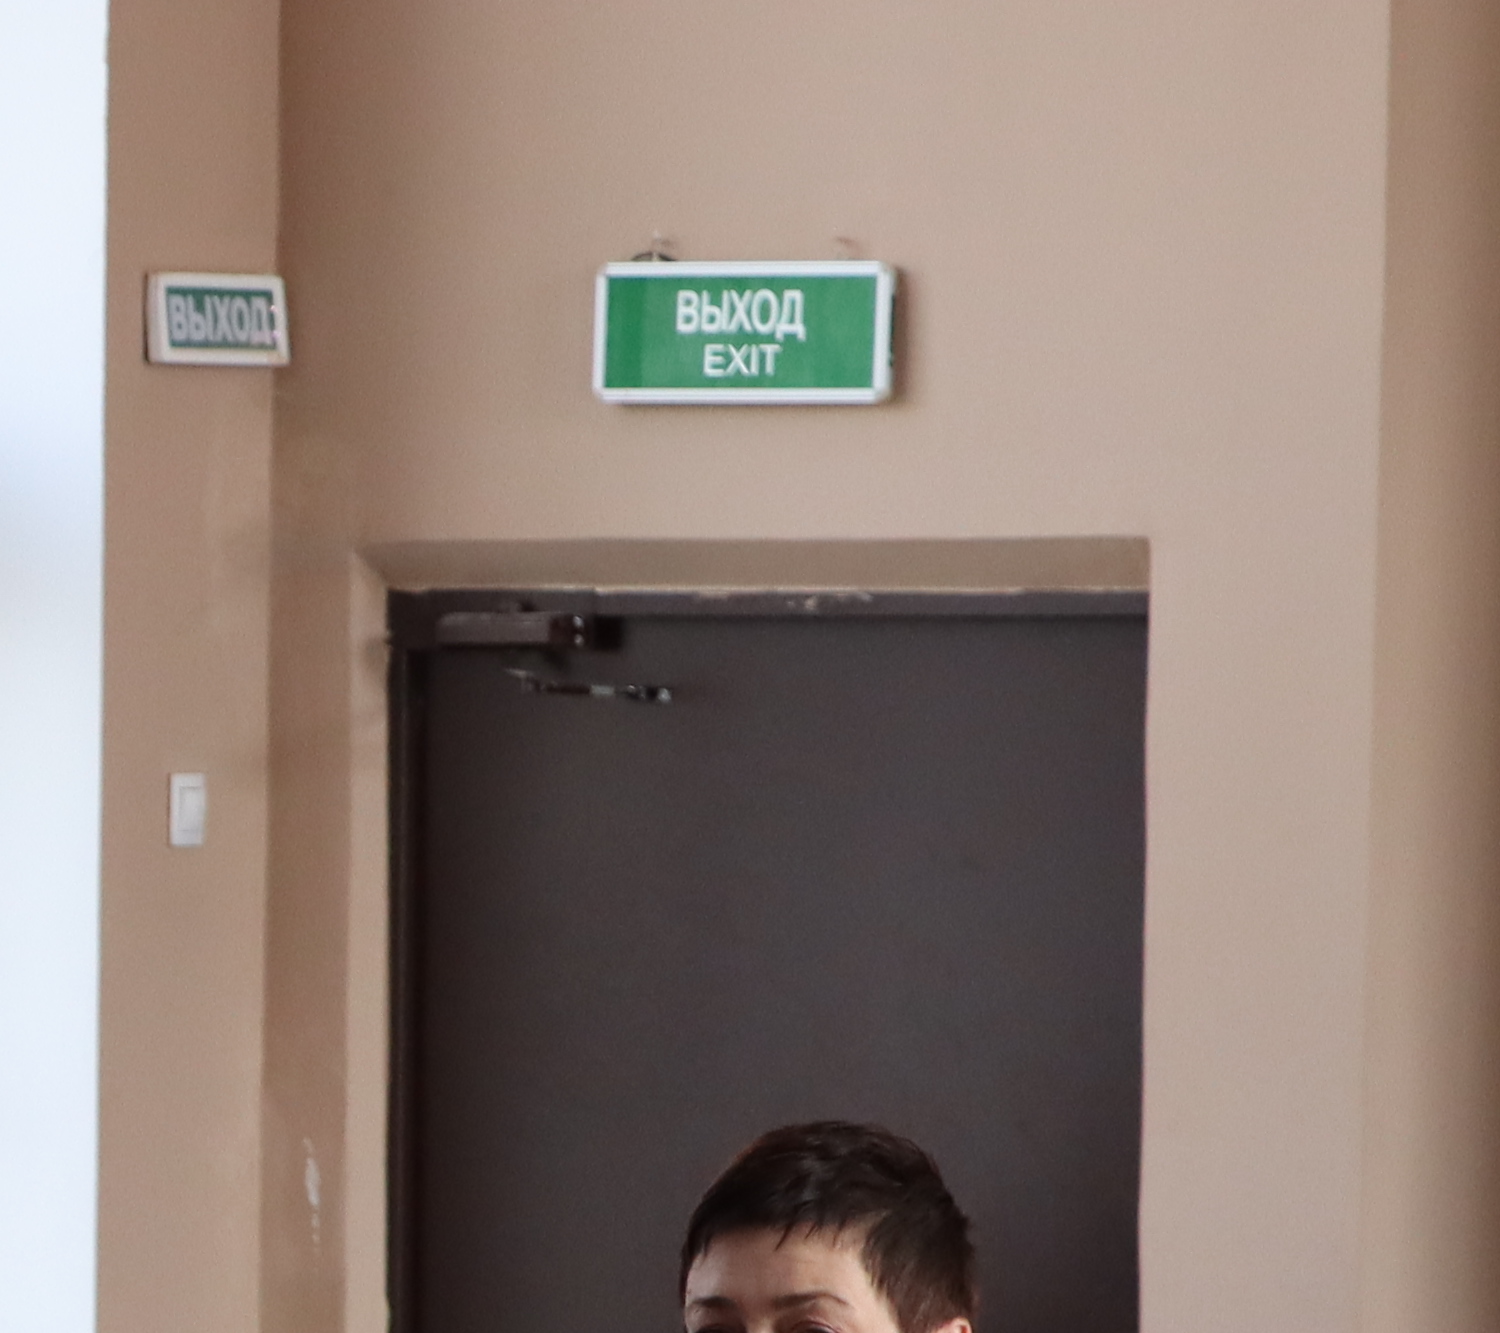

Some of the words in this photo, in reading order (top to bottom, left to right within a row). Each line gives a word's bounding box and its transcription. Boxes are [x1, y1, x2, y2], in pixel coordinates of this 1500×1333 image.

[169, 294, 273, 346] ВЫХОД
[676, 288, 807, 342] ВЫХОД
[703, 343, 783, 377] EXIT
